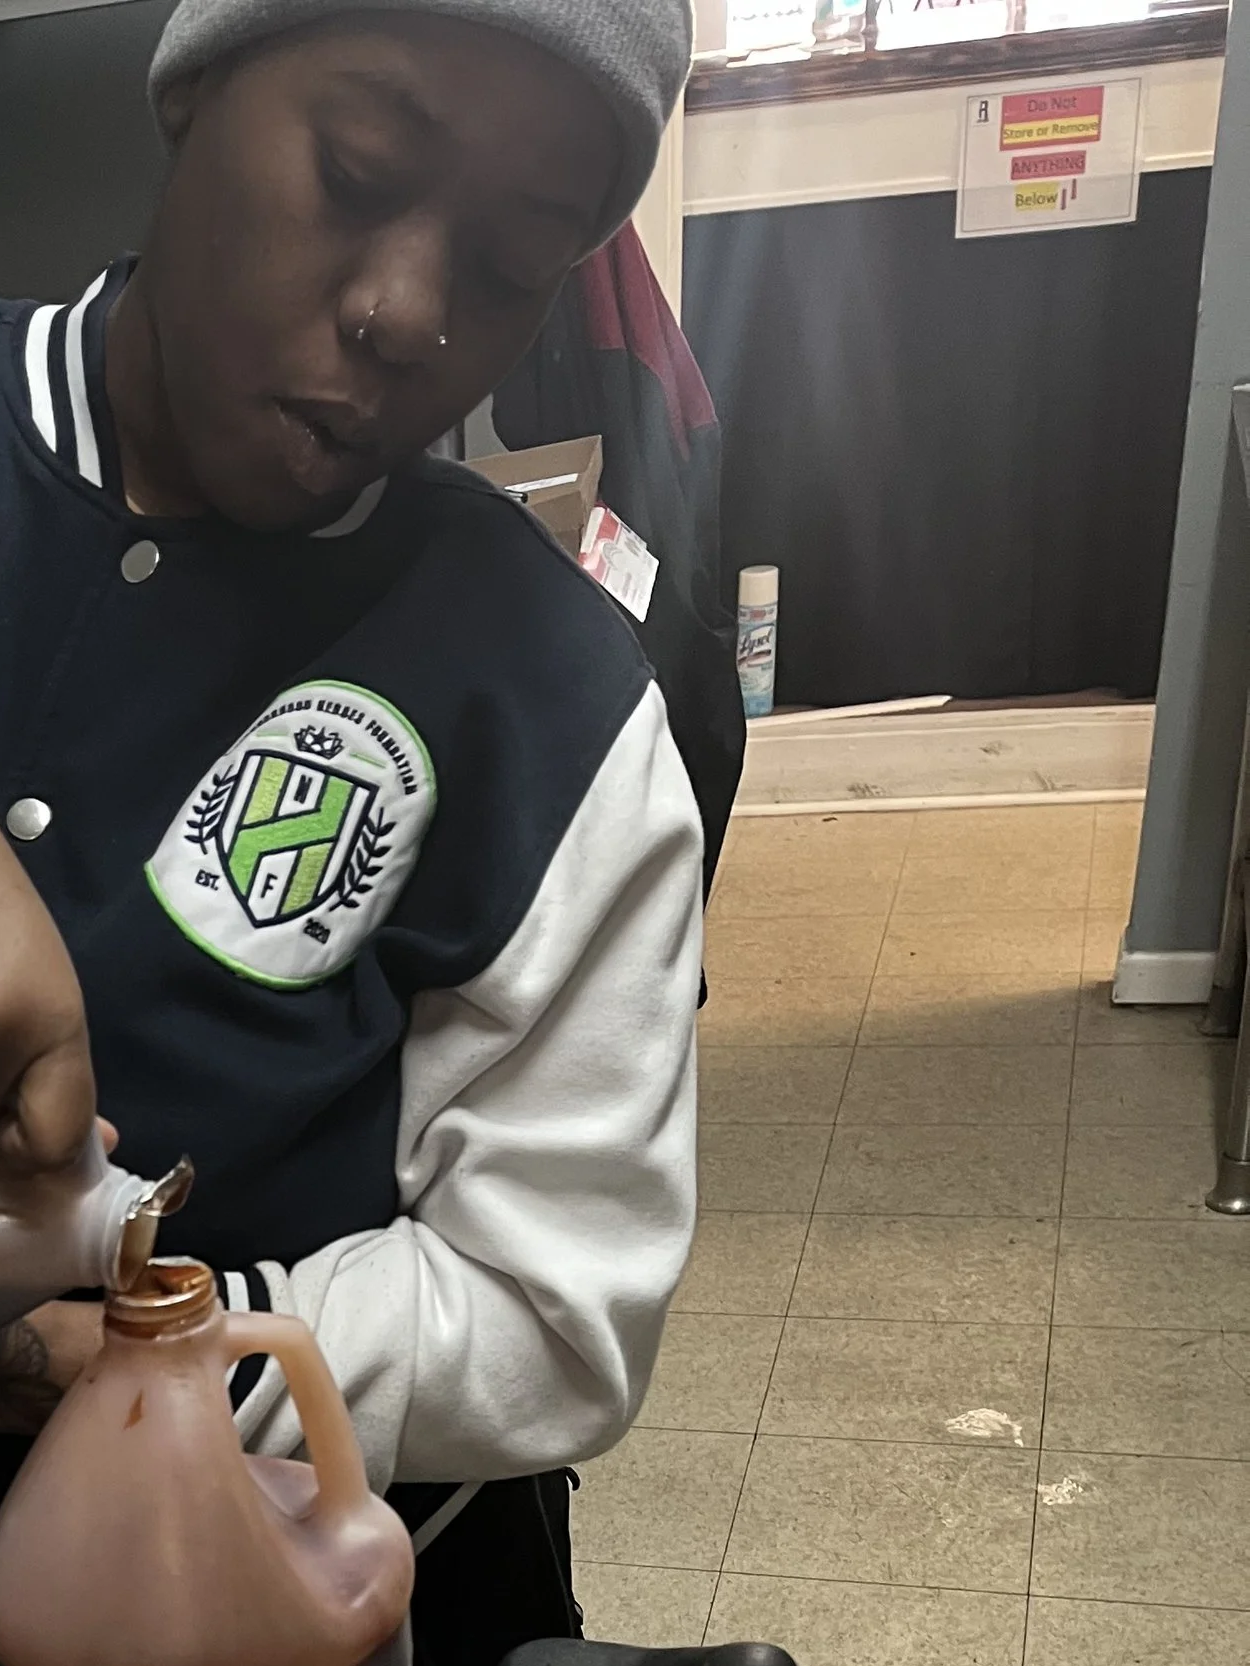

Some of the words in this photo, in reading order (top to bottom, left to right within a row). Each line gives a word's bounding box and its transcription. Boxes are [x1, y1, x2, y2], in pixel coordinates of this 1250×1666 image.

[1027, 99, 1048, 112] Do
[1052, 97, 1077, 110] Not
[1003, 127, 1033, 139] Store
[1036, 127, 1049, 137] or
[1051, 121, 1100, 134] Remove
[1011, 155, 1085, 176] ANYTHING
[1015, 192, 1058, 207] Below
[260, 873, 279, 898] F
